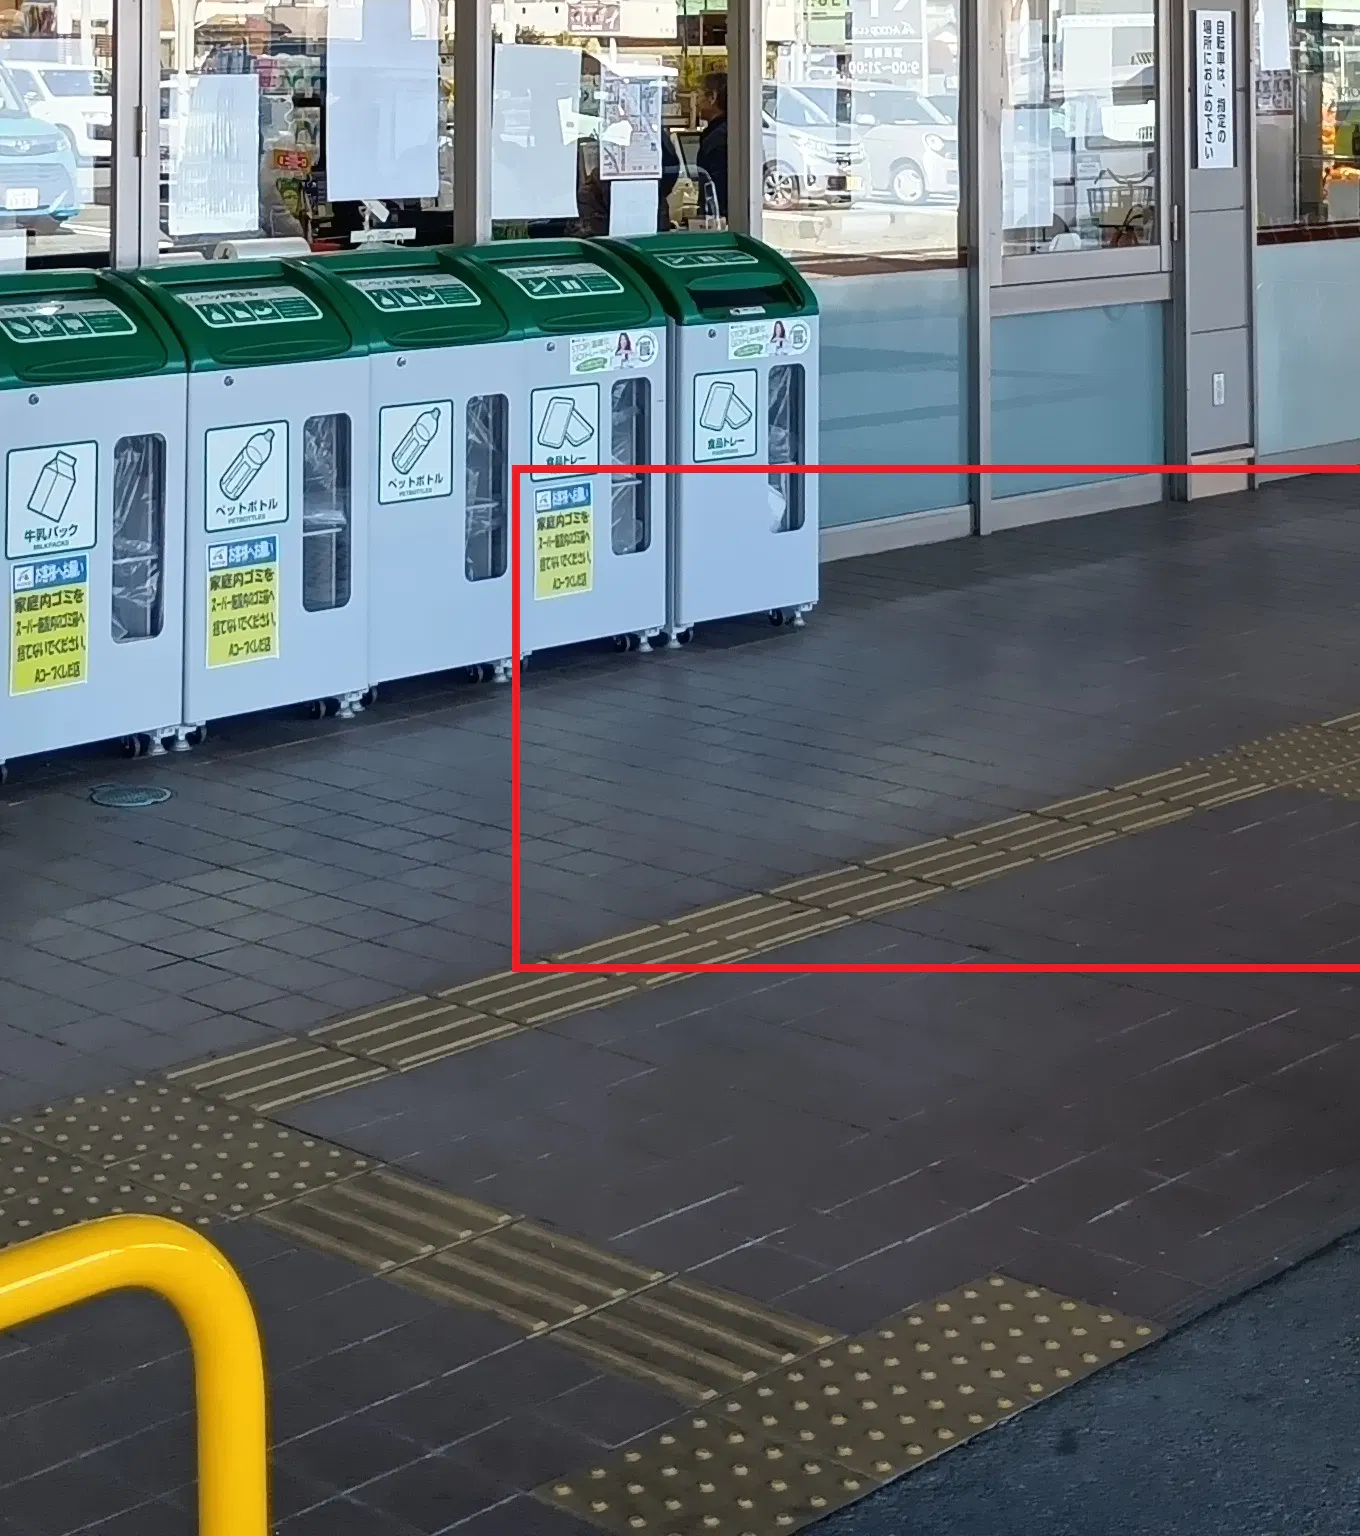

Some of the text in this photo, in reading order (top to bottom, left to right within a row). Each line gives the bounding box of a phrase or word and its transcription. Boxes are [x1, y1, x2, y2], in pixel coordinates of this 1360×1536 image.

[1203, 20, 1214, 159] 場所にお止め下さい
[1216, 20, 1227, 143] 自転車は、指定の
[707, 437, 745, 450] 食品トレー
[387, 474, 444, 489] ペットボトル
[215, 498, 279, 517] ペットボトル
[24, 524, 78, 543] 牛乳パック
[210, 567, 275, 591] 家庭内ゴミを
[14, 588, 85, 614] 家庭内ゴミを
